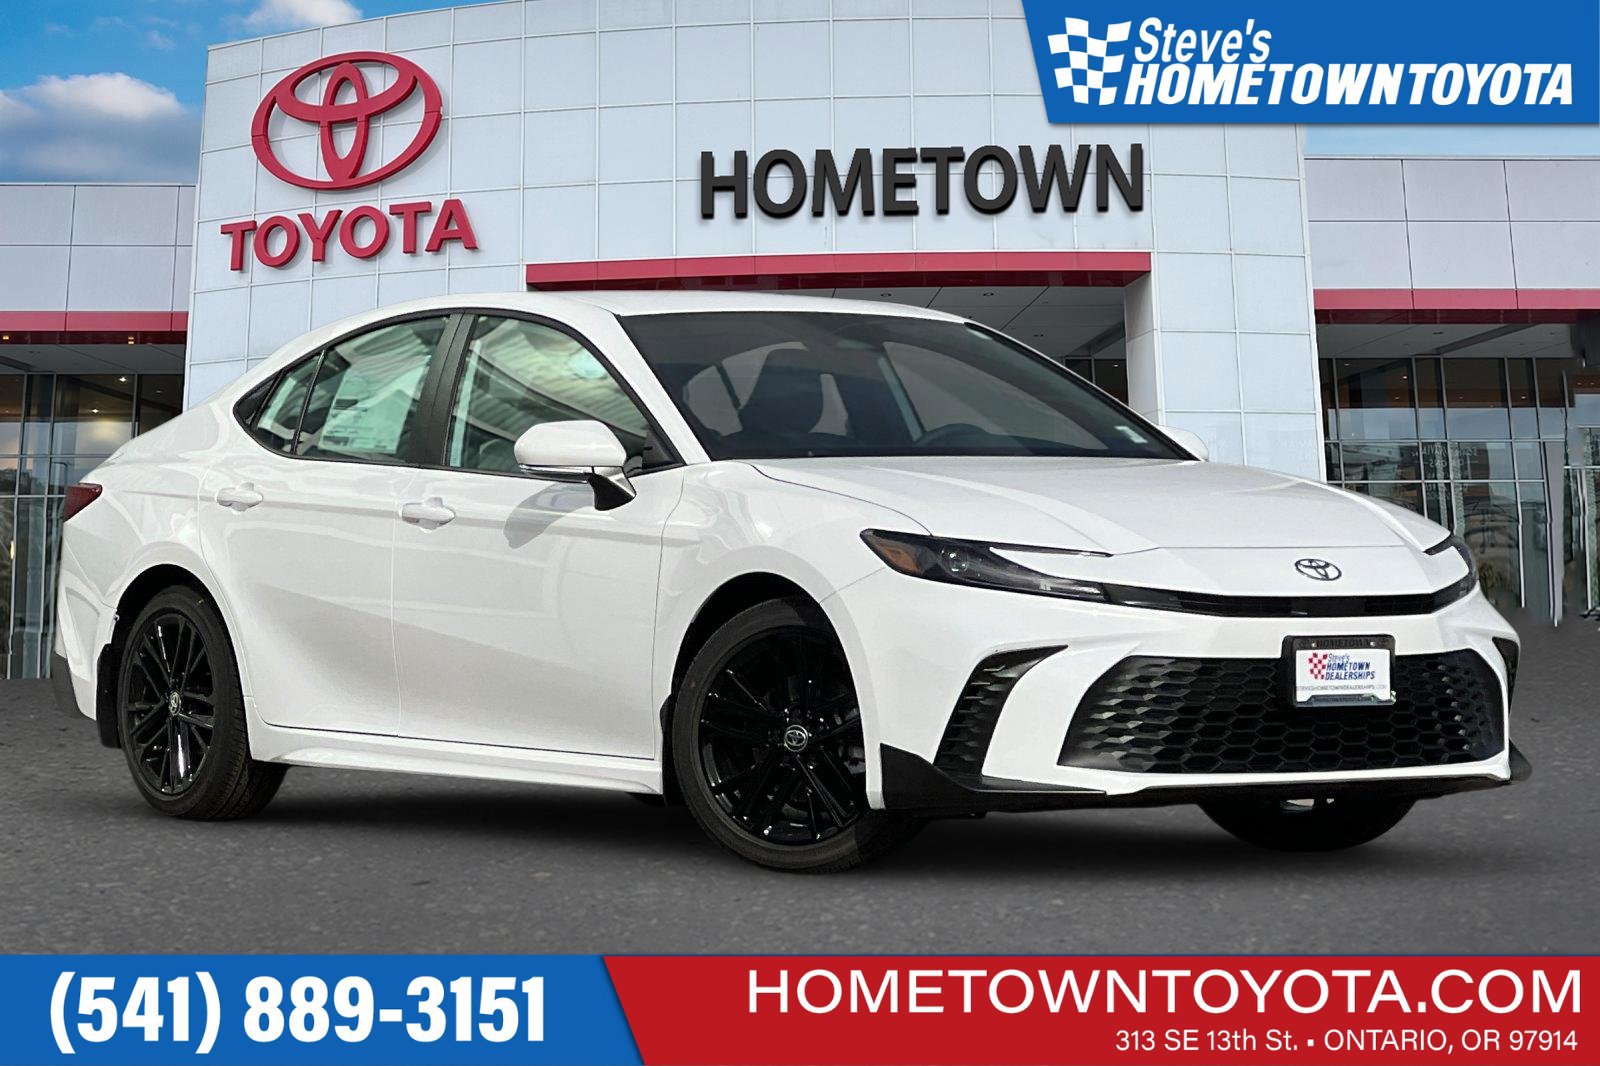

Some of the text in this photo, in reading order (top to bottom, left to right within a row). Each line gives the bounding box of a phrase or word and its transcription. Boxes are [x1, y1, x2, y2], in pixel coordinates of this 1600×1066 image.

[700, 143, 1143, 219] HOMETOWN
[220, 198, 478, 271] TOYOTA
[1328, 653, 1350, 662] Steve's
[1326, 662, 1371, 671] HOMETOWN
[1325, 671, 1376, 680] DEALERSHIPS
